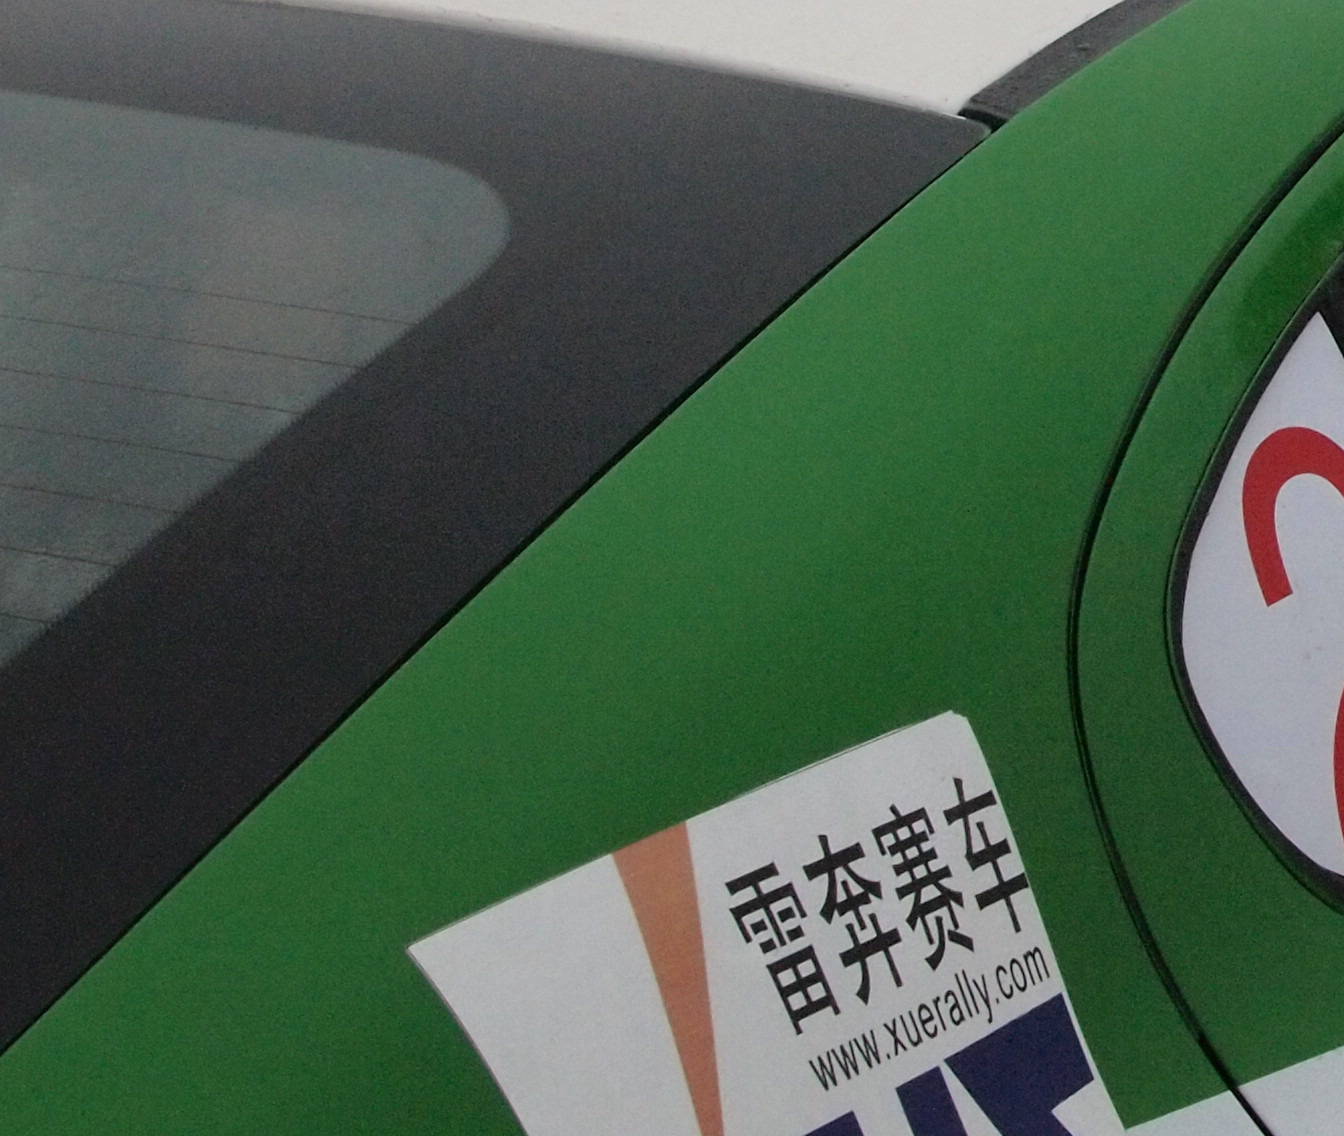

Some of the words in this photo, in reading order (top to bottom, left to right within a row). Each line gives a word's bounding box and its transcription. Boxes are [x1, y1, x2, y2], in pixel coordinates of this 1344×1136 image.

[725, 776, 1030, 1036] 雷奔赛车
[808, 945, 1051, 1092] www.xuerally.com
